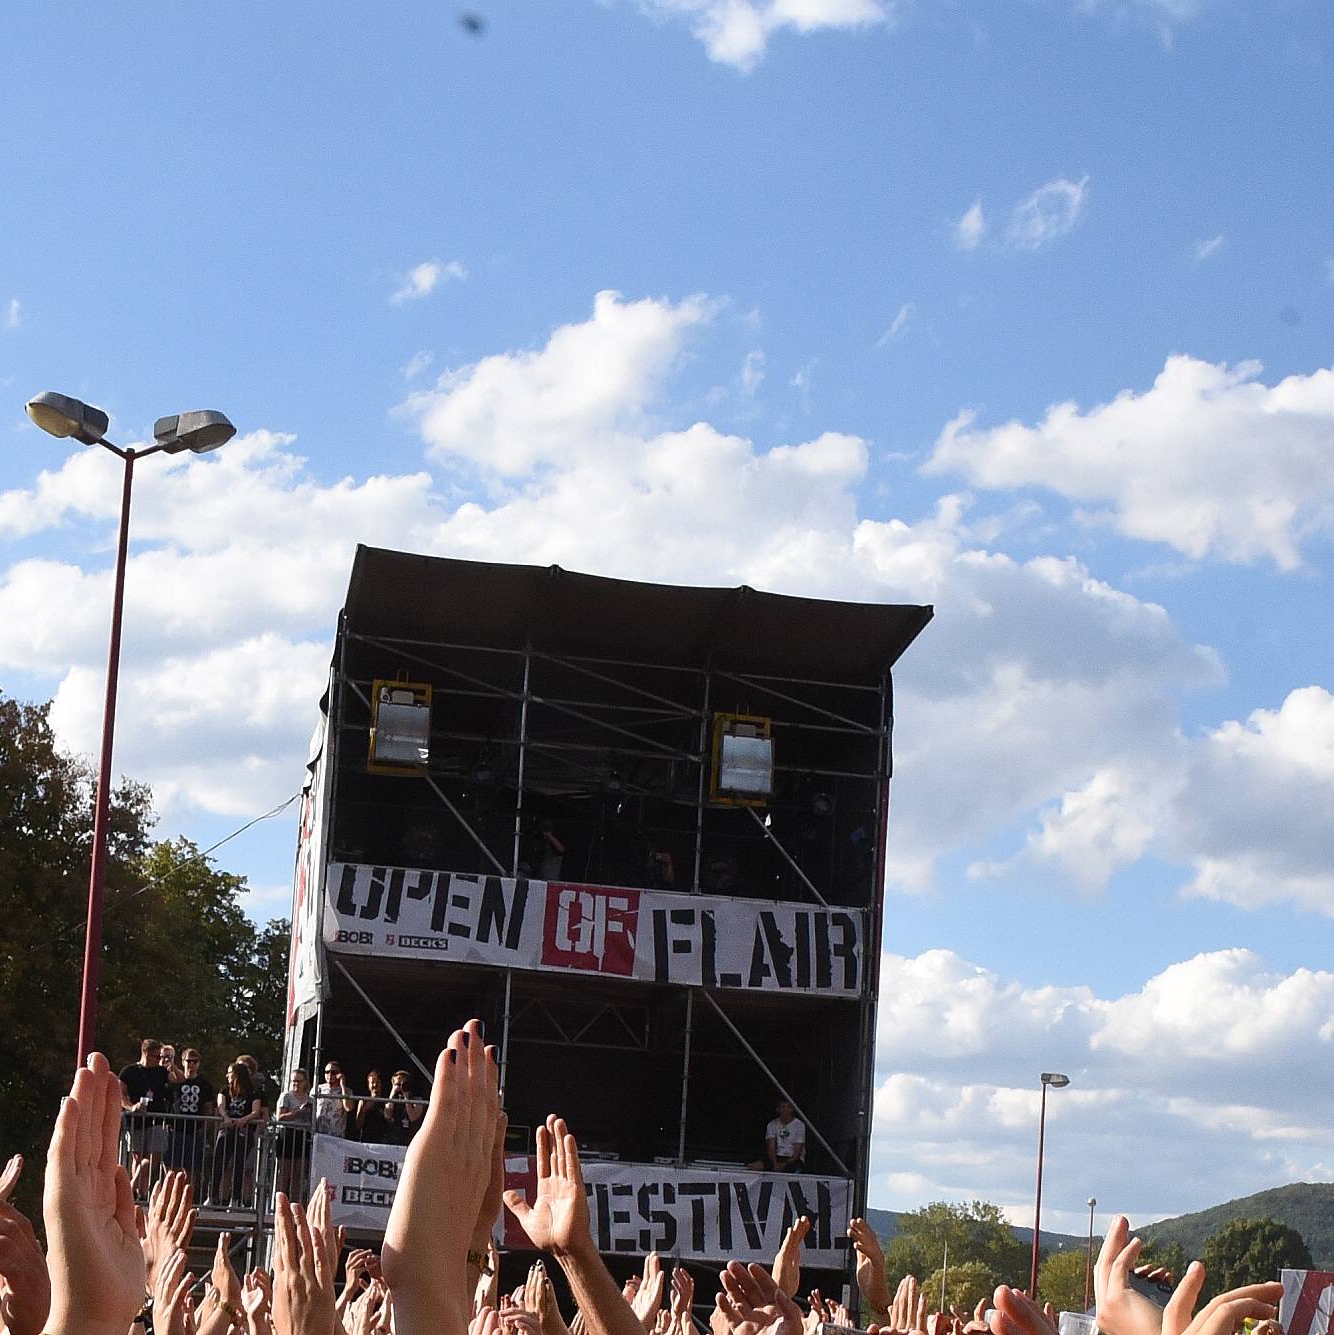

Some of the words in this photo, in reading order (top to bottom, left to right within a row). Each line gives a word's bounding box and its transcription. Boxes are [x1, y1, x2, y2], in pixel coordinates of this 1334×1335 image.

[336, 864, 529, 950] OPEN
[555, 888, 635, 959] OF
[653, 908, 860, 990] FLAIR
[347, 1157, 399, 1179] BOB!
[344, 1189, 395, 1205] BECK
[585, 1181, 851, 1253] ESTIVAL
